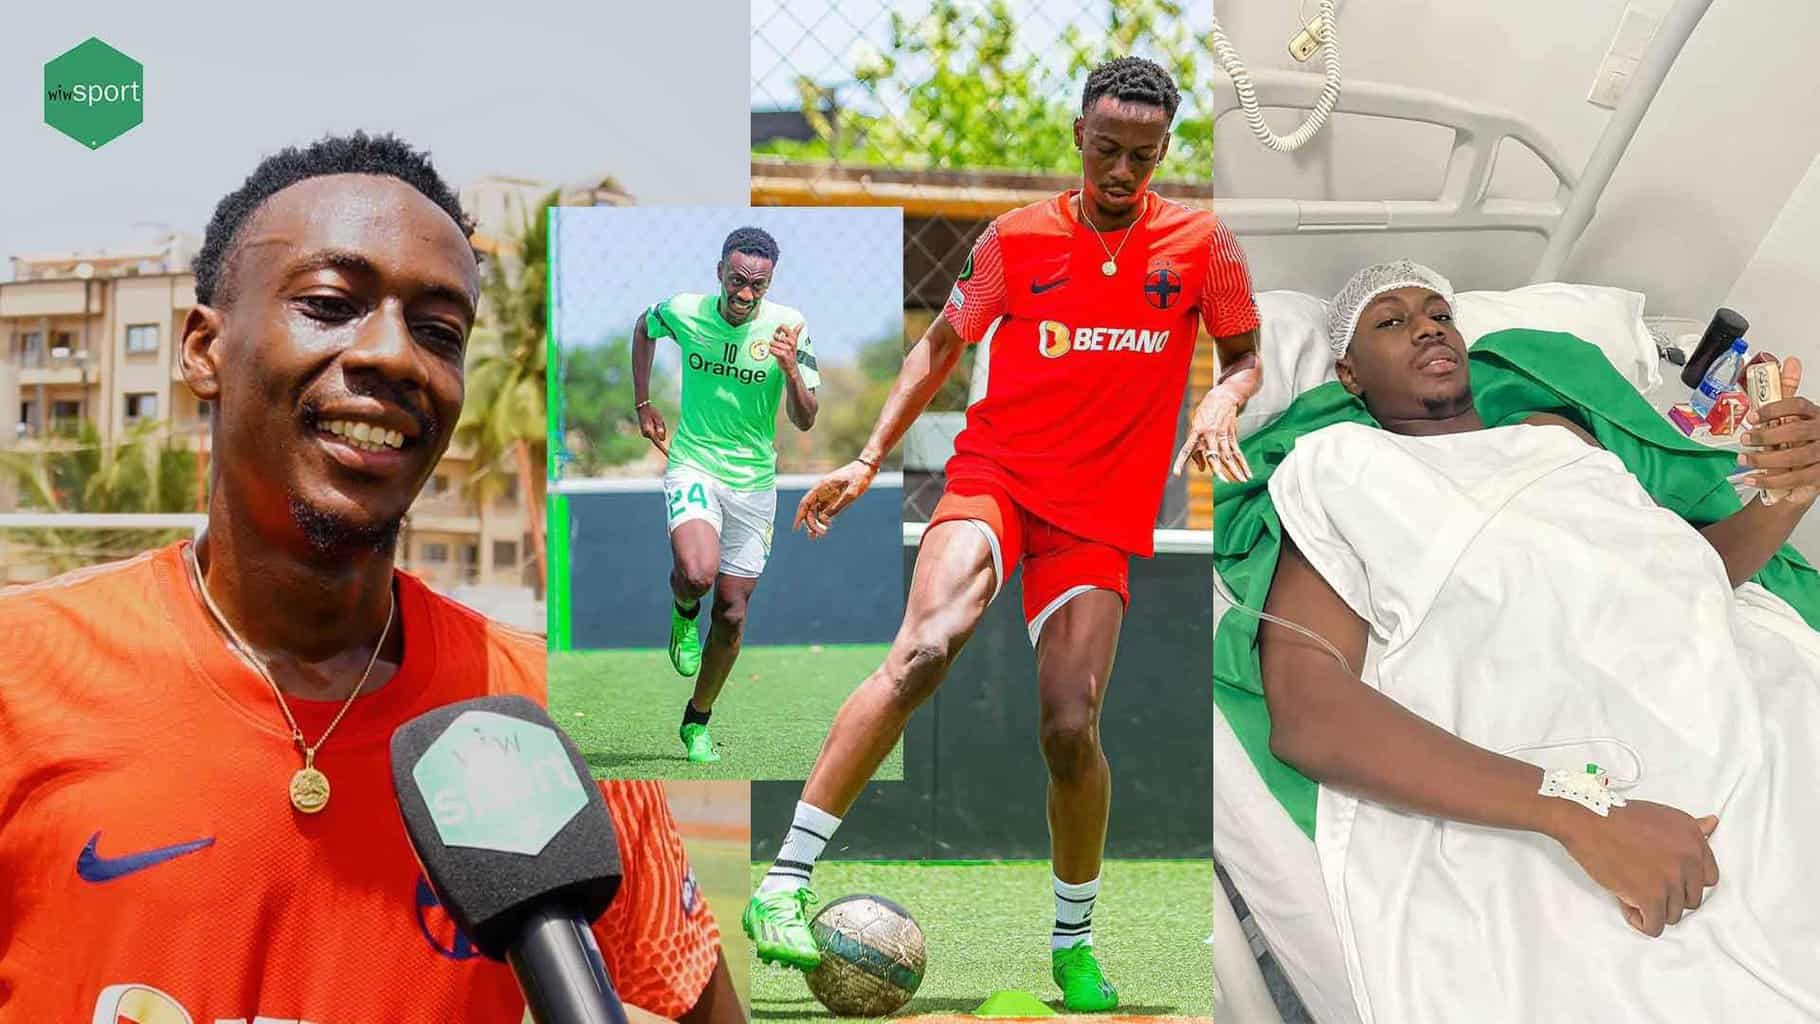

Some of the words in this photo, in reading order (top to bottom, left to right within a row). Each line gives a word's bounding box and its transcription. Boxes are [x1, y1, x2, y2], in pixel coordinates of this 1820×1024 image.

[723, 342, 738, 364] 10
[1073, 327, 1170, 353] BETANO
[688, 353, 767, 384] Orange
[666, 483, 707, 520] 24
